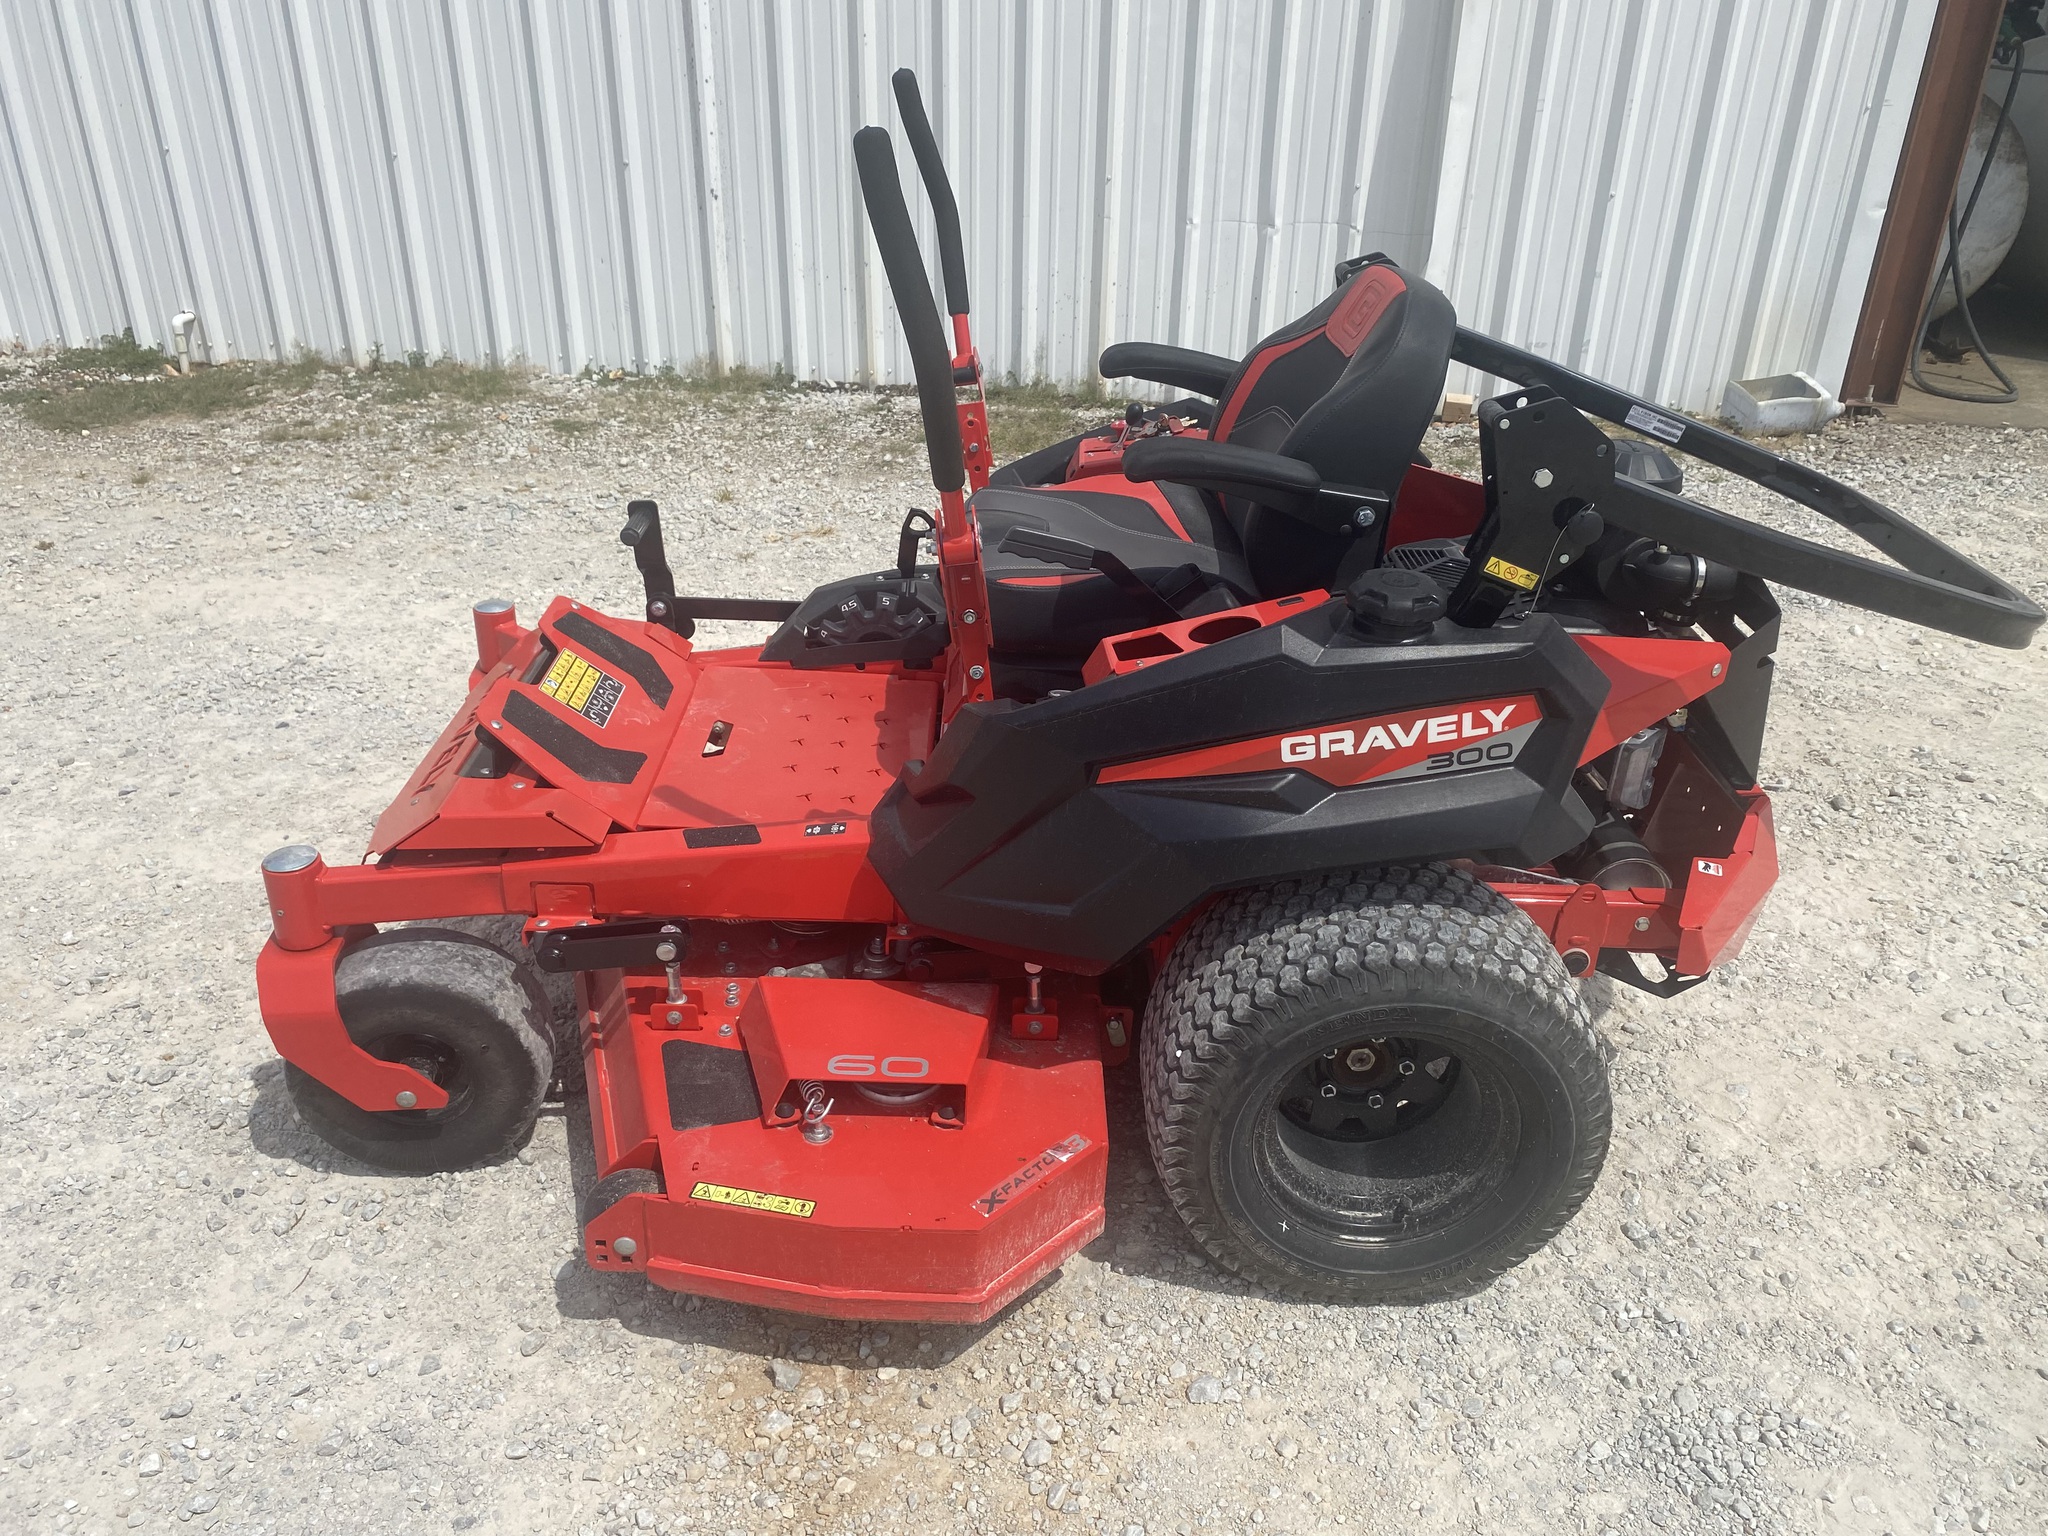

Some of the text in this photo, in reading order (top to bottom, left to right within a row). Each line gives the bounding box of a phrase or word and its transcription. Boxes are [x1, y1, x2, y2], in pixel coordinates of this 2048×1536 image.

[881, 597, 891, 607] 5
[1280, 704, 1517, 763] GRAVELY
[1426, 742, 1514, 771] 300
[827, 1054, 930, 1078] 60
[1485, 1204, 1544, 1258] SUPER
